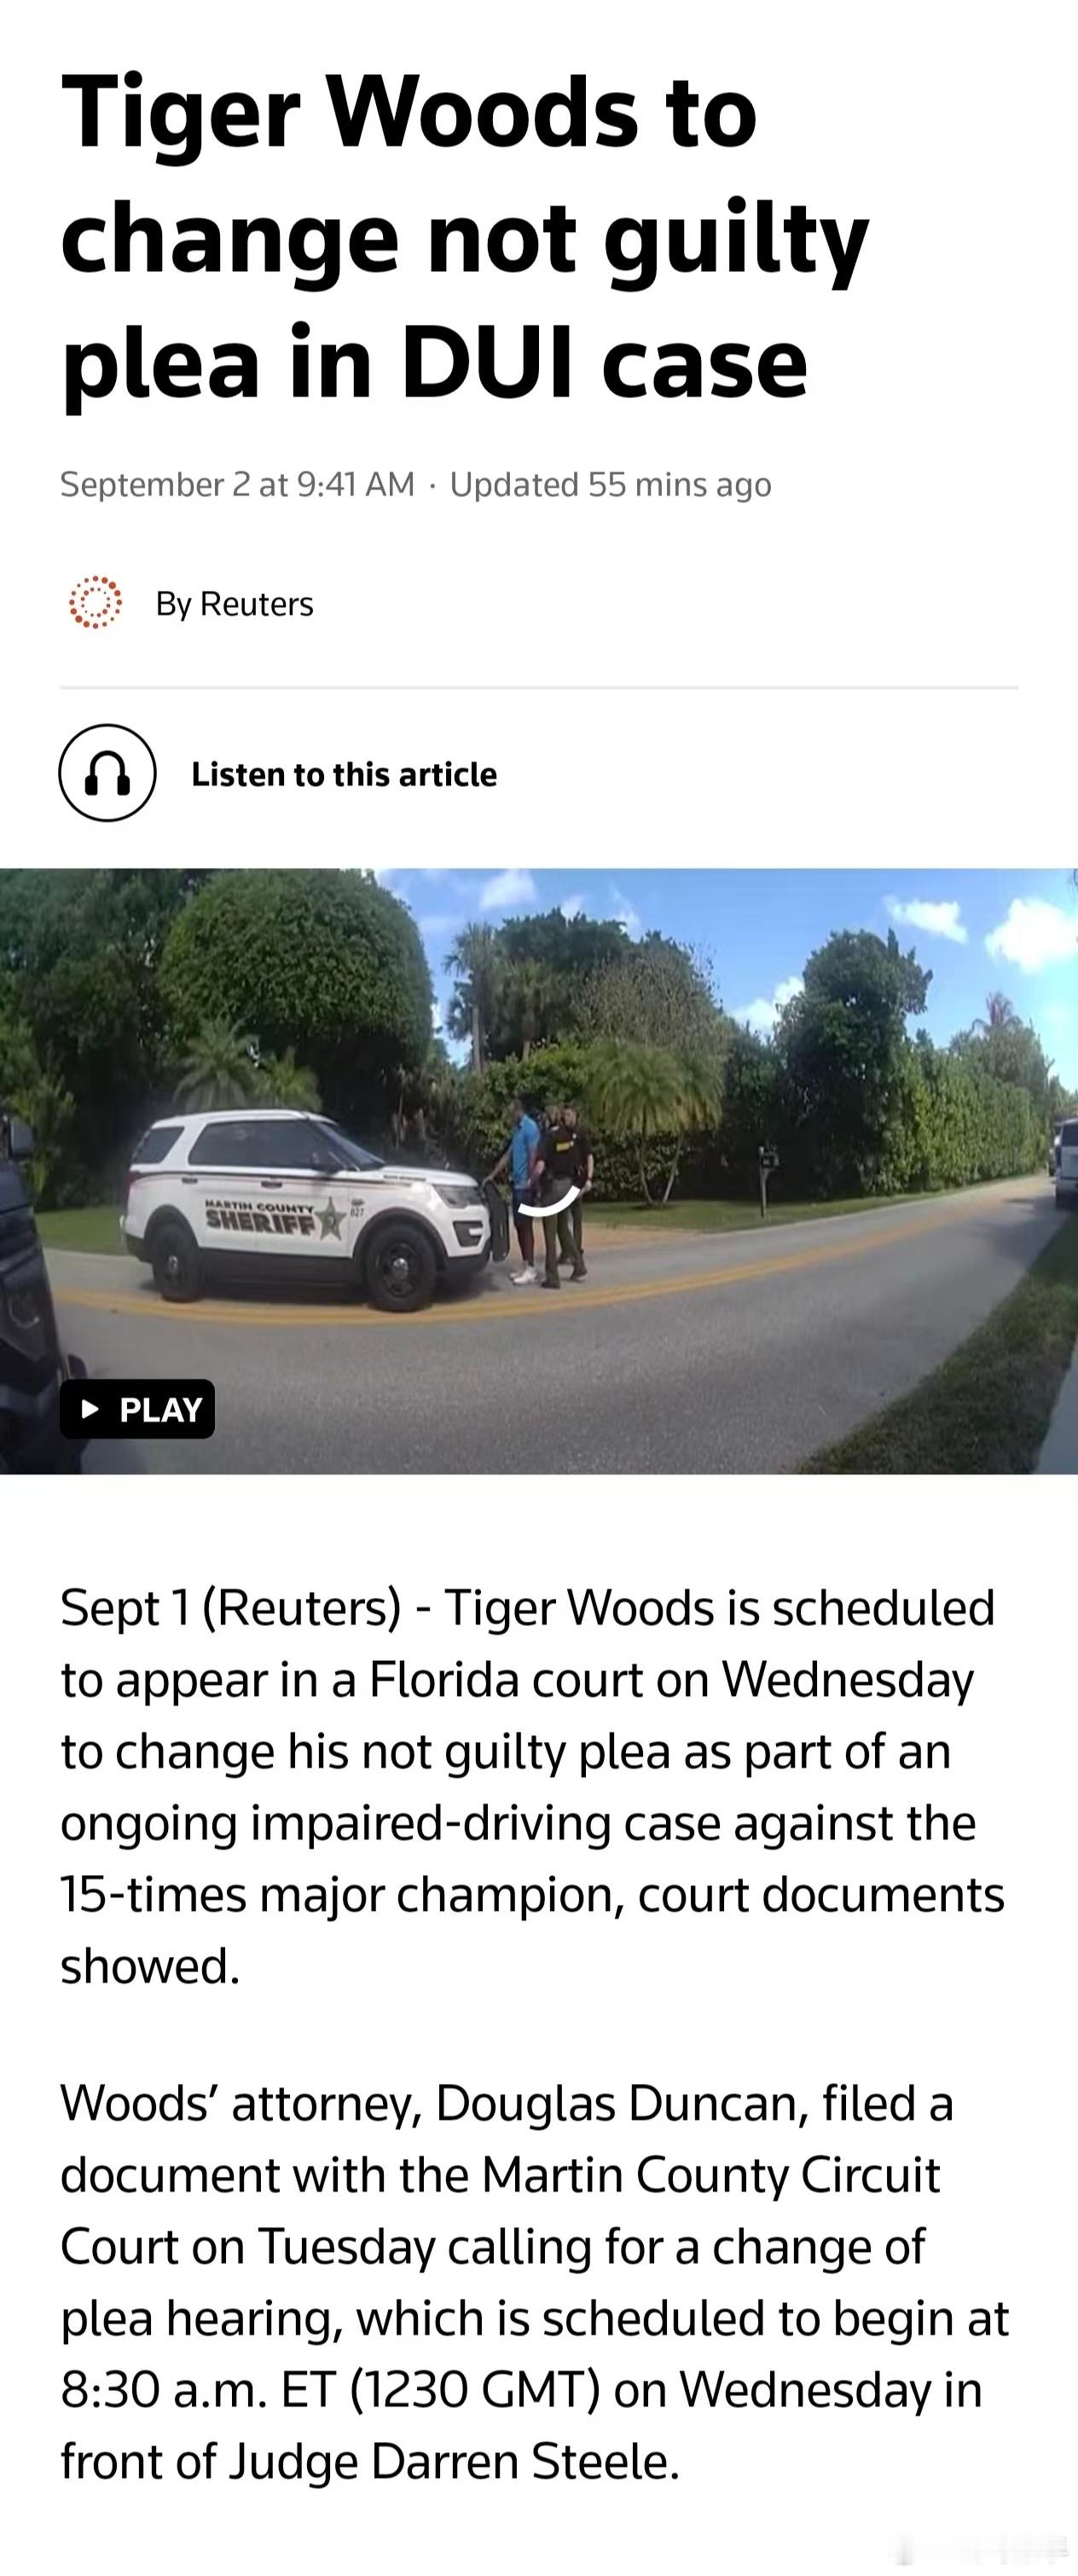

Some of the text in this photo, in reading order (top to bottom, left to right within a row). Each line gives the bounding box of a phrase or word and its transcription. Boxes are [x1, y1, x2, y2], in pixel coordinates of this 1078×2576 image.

[62, 70, 756, 167] Tiger Woods to
[62, 195, 870, 292] change not guilty
[66, 321, 806, 416] plea in DUI case
[61, 471, 224, 502] September
[234, 471, 250, 496] 2
[260, 474, 288, 497] at
[298, 471, 354, 497] 9:41
[366, 472, 413, 496] AM
[452, 472, 577, 502] Updated
[590, 472, 625, 497] 55
[637, 472, 706, 496] mins
[717, 478, 771, 503] ago
[158, 591, 313, 622] By Reuters
[193, 761, 497, 787] Listen to this article
[206, 1200, 314, 1213] MARTIN COUNTY
[206, 1208, 316, 1236] SHERIFF
[62, 1588, 159, 1635] Sept
[172, 1589, 186, 1625] 1
[204, 1584, 400, 1633] (Reuters)
[444, 1589, 556, 1635] Tiger
[567, 1589, 714, 1626] Woods
[729, 1589, 759, 1626] is
[774, 1589, 993, 1626] scheduled
[61, 1660, 974, 1706] to appear in a Florida court on Wednesday
[61, 1731, 949, 1779] to change his not guilty plea as part of an
[61, 1803, 976, 1850] ongoing impaired-driving case against the
[61, 1875, 1004, 1922] 15-times major champion, court documents
[61, 1947, 238, 1984] showed.
[233, 2087, 420, 2130] attorney,
[439, 2084, 615, 2131] Douglas
[631, 2084, 808, 2128] Duncan,
[823, 2083, 914, 2122] filed
[930, 2093, 952, 2122] a
[61, 2155, 940, 2202] document with the Martin County Circuit
[62, 2226, 926, 2274] Court on Tuesday calling for a change of
[63, 2299, 1009, 2346] plea hearing, which is scheduled to begin at
[62, 2366, 981, 2417] 8:30 a.m. ET (1230 GMT) on Wednesday in
[61, 2441, 678, 2489] front of Judge Darren Steele.
